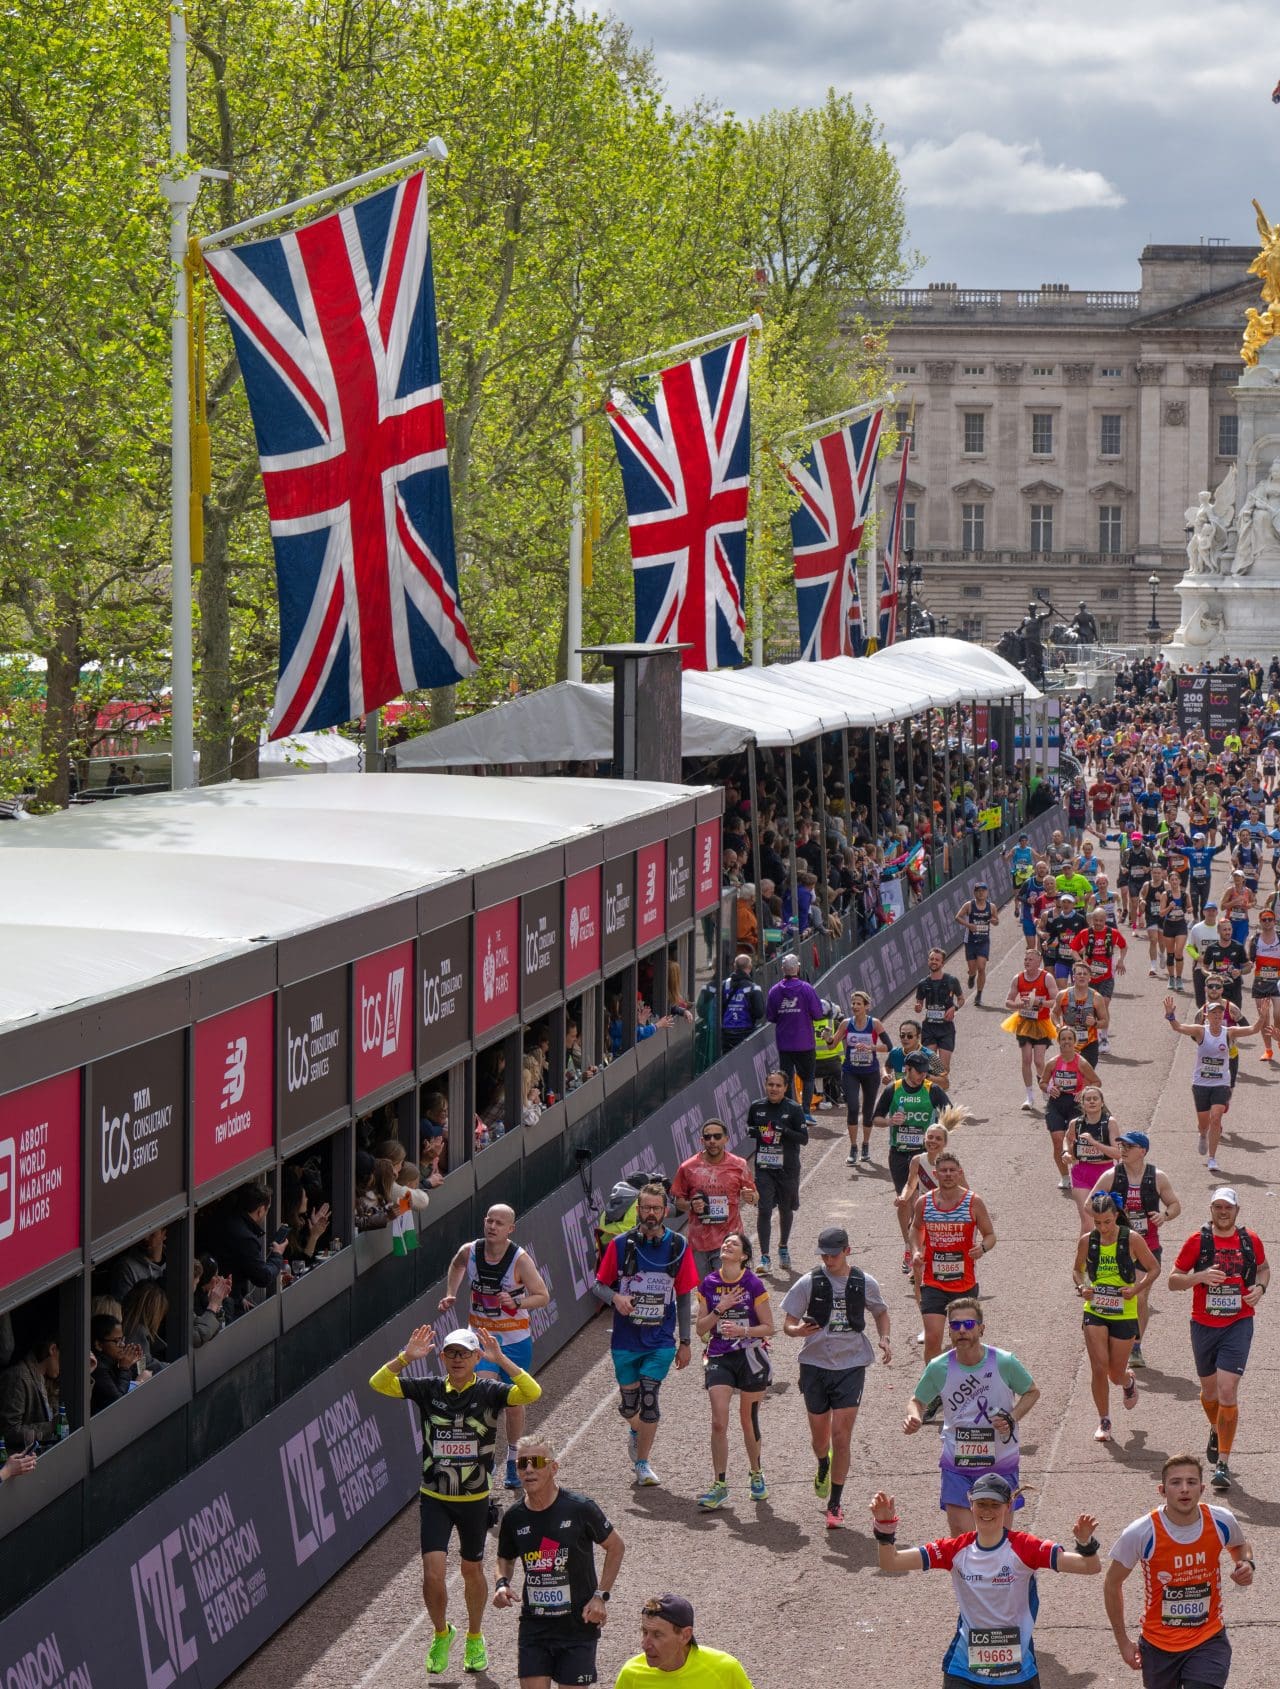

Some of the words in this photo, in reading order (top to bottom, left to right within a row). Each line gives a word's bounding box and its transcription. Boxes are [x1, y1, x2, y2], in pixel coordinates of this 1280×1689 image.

[1183, 693, 1203, 702] 200
[669, 860, 679, 903] tcs
[606, 888, 617, 935] tcs
[495, 944, 510, 968] ROYAL
[526, 923, 540, 976] tcs
[423, 968, 441, 1026] tcs
[495, 972, 509, 996] PARKS
[310, 1012, 323, 1034] TATA
[362, 984, 382, 1053] tcs
[310, 1028, 339, 1058] CONSULTANCY
[287, 1026, 309, 1093] tcs
[310, 1057, 329, 1082] SERVICES
[133, 1087, 151, 1114] TATA
[899, 1096, 921, 1104] CHRIS
[133, 1104, 172, 1141] CONSULTANCY
[20, 1122, 49, 1152] ABBOTT
[102, 1105, 130, 1184] tcs
[20, 1149, 46, 1175] WORLD
[132, 1142, 158, 1171] SERVICES
[19, 1166, 62, 1205] MARATHON
[19, 1197, 50, 1231] MAJORS
[1211, 1297, 1236, 1307] 55634
[948, 1374, 980, 1412] JOSH
[319, 1390, 361, 1449] LONDON
[436, 1427, 452, 1439] tcs
[957, 1429, 970, 1440] tcs
[329, 1415, 383, 1485] MARATHON
[440, 1444, 471, 1454] 10285
[960, 1444, 989, 1454] 17704
[338, 1463, 375, 1520] EVENTS
[181, 1492, 236, 1563] LONDON
[192, 1519, 262, 1602] MARATHON
[526, 1559, 553, 1570] CLASS
[554, 1556, 568, 1569] OF
[1174, 1551, 1206, 1569] DOM
[527, 1573, 541, 1585] tcs
[533, 1589, 563, 1602] 62660
[1165, 1588, 1184, 1599] tcs
[202, 1576, 250, 1645] EVENTS
[1170, 1602, 1204, 1615] 60680
[972, 1631, 990, 1644] tcs
[0, 1631, 64, 1689] ONDON
[977, 1649, 1013, 1663] 19663
